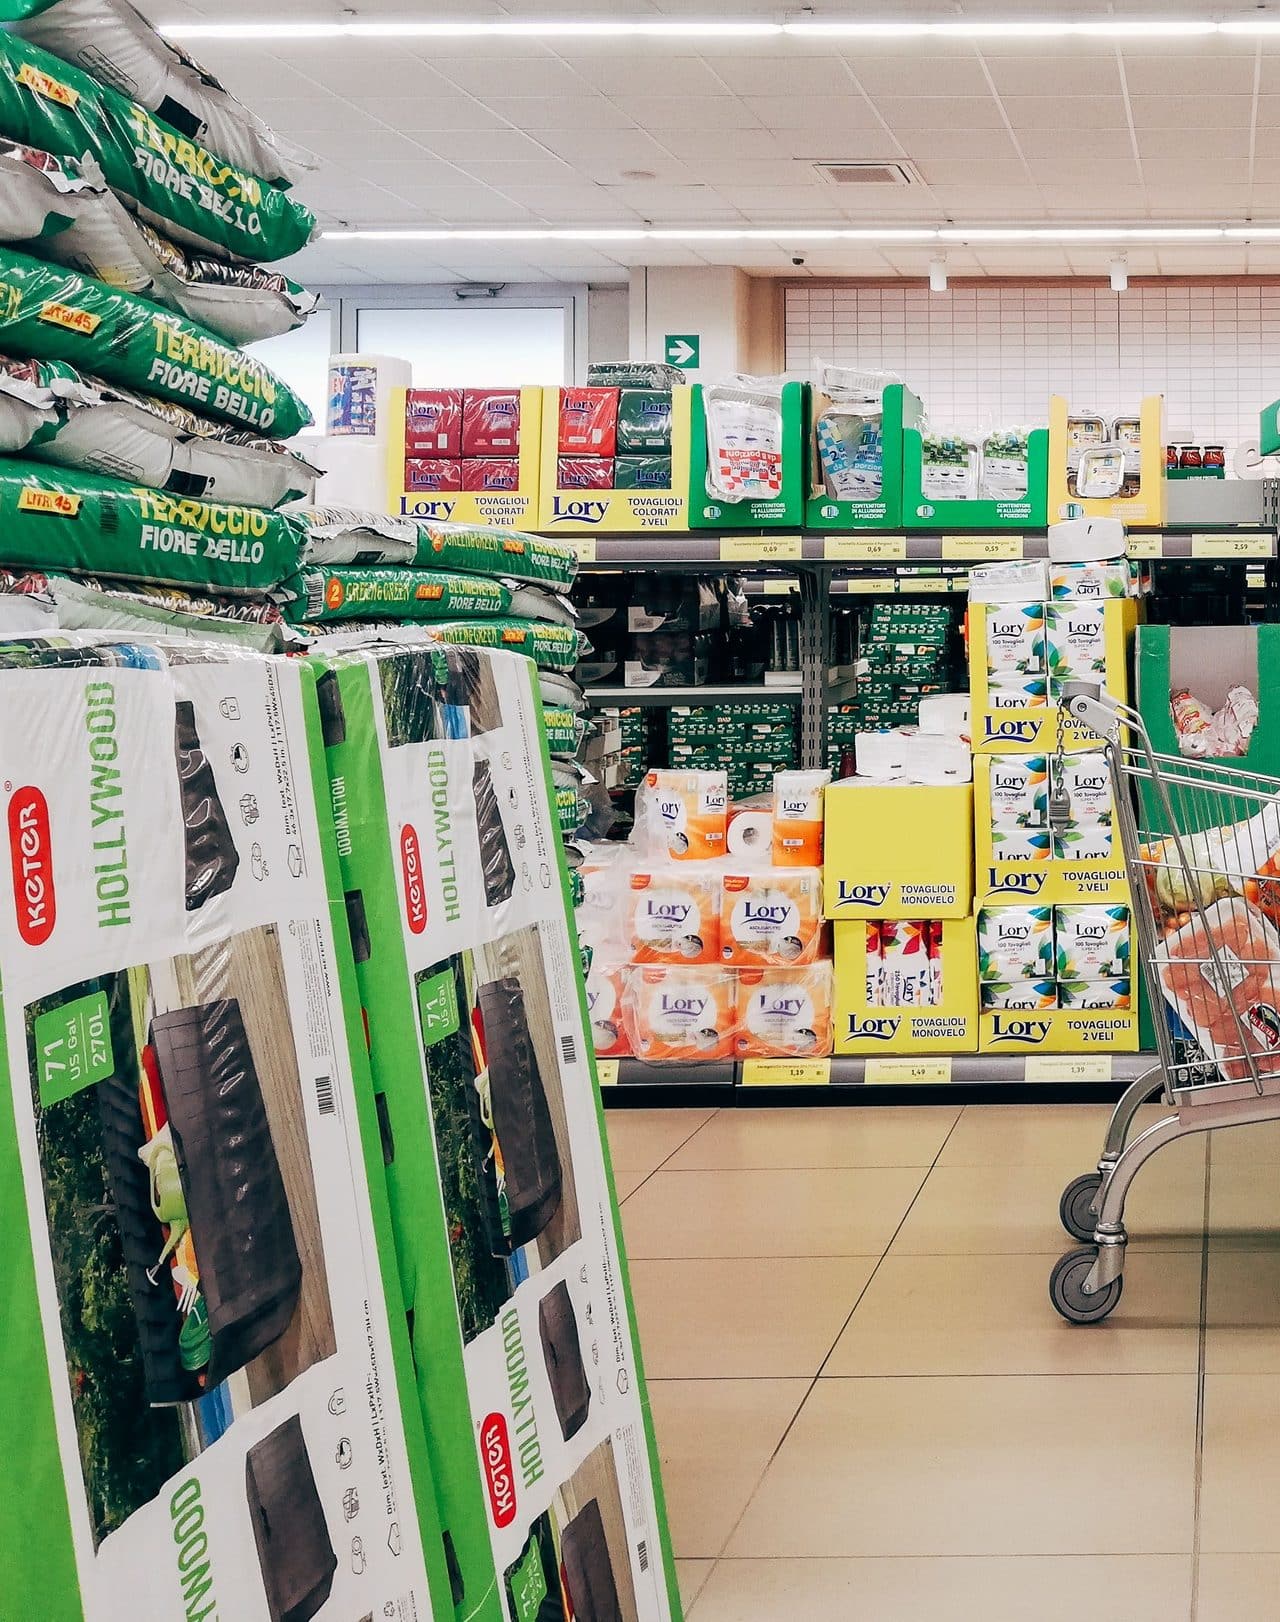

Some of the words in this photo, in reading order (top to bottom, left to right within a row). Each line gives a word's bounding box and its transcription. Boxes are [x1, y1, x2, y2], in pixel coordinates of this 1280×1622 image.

[134, 146, 195, 202] FIORE
[197, 186, 262, 236] BELLO
[73, 312, 93, 331] 45
[147, 358, 211, 401] FIORE
[213, 384, 276, 430] BELLO
[487, 400, 518, 414] Lory
[564, 397, 596, 412] Lory
[640, 400, 671, 415] Lory
[411, 471, 442, 484] Lory
[484, 474, 515, 488] Lory
[560, 472, 592, 486] Lory
[636, 470, 669, 483] Lory
[53, 491, 73, 512] 45
[400, 496, 456, 521] Lory
[474, 497, 530, 506] TOVAGLIOLI
[628, 498, 683, 507] TOVAGLIOLI
[479, 508, 525, 516] COLORATI
[553, 497, 610, 523] Lory
[633, 508, 678, 517] COLORATI
[495, 518, 515, 526] VELI
[648, 518, 669, 527] VELI
[139, 525, 198, 556] FIORE
[202, 533, 266, 565] BELLO
[867, 545, 882, 553] 0,69
[1234, 543, 1249, 552] 2,59
[447, 596, 474, 610] FIORE
[474, 597, 502, 611] BELLO
[993, 621, 1025, 637] Lory
[1068, 621, 1101, 637] Lory
[984, 715, 1042, 739] Lory
[994, 773, 1027, 787] Lory
[1074, 774, 1107, 788] Lory
[84, 681, 132, 929] HOLLYWOOD
[783, 799, 809, 812] Lory
[331, 775, 352, 858] HOLLYWOOD
[427, 749, 461, 924] HOLLYWOOD
[989, 867, 1047, 891] Lory
[1062, 870, 1126, 881] TOVAGLIOLI
[838, 880, 890, 906] Lory
[900, 884, 956, 894] TOVAGLIOLI
[1086, 882, 1109, 892] VELI
[901, 895, 955, 905] MONOVELO
[648, 899, 692, 922] Lory
[744, 901, 792, 922] Lory
[998, 923, 1032, 938] Lory
[1075, 923, 1109, 938] Lory
[661, 994, 709, 1014] Lory
[426, 997, 442, 1030] 71
[848, 1014, 901, 1039] Lory
[911, 1017, 967, 1028] TOVAGLIOLI
[993, 1015, 1052, 1041] Lory
[1067, 1019, 1131, 1030] TOVAGLIOLI
[66, 1018, 79, 1051] Gal
[89, 1003, 108, 1068] 270L
[911, 1028, 966, 1038] MONOVELO
[1090, 1031, 1114, 1041] VELI
[43, 1036, 67, 1083] 71
[68, 1055, 82, 1082] US
[911, 1067, 926, 1078] 1,49
[501, 1307, 545, 1490] HOLLYWOOD
